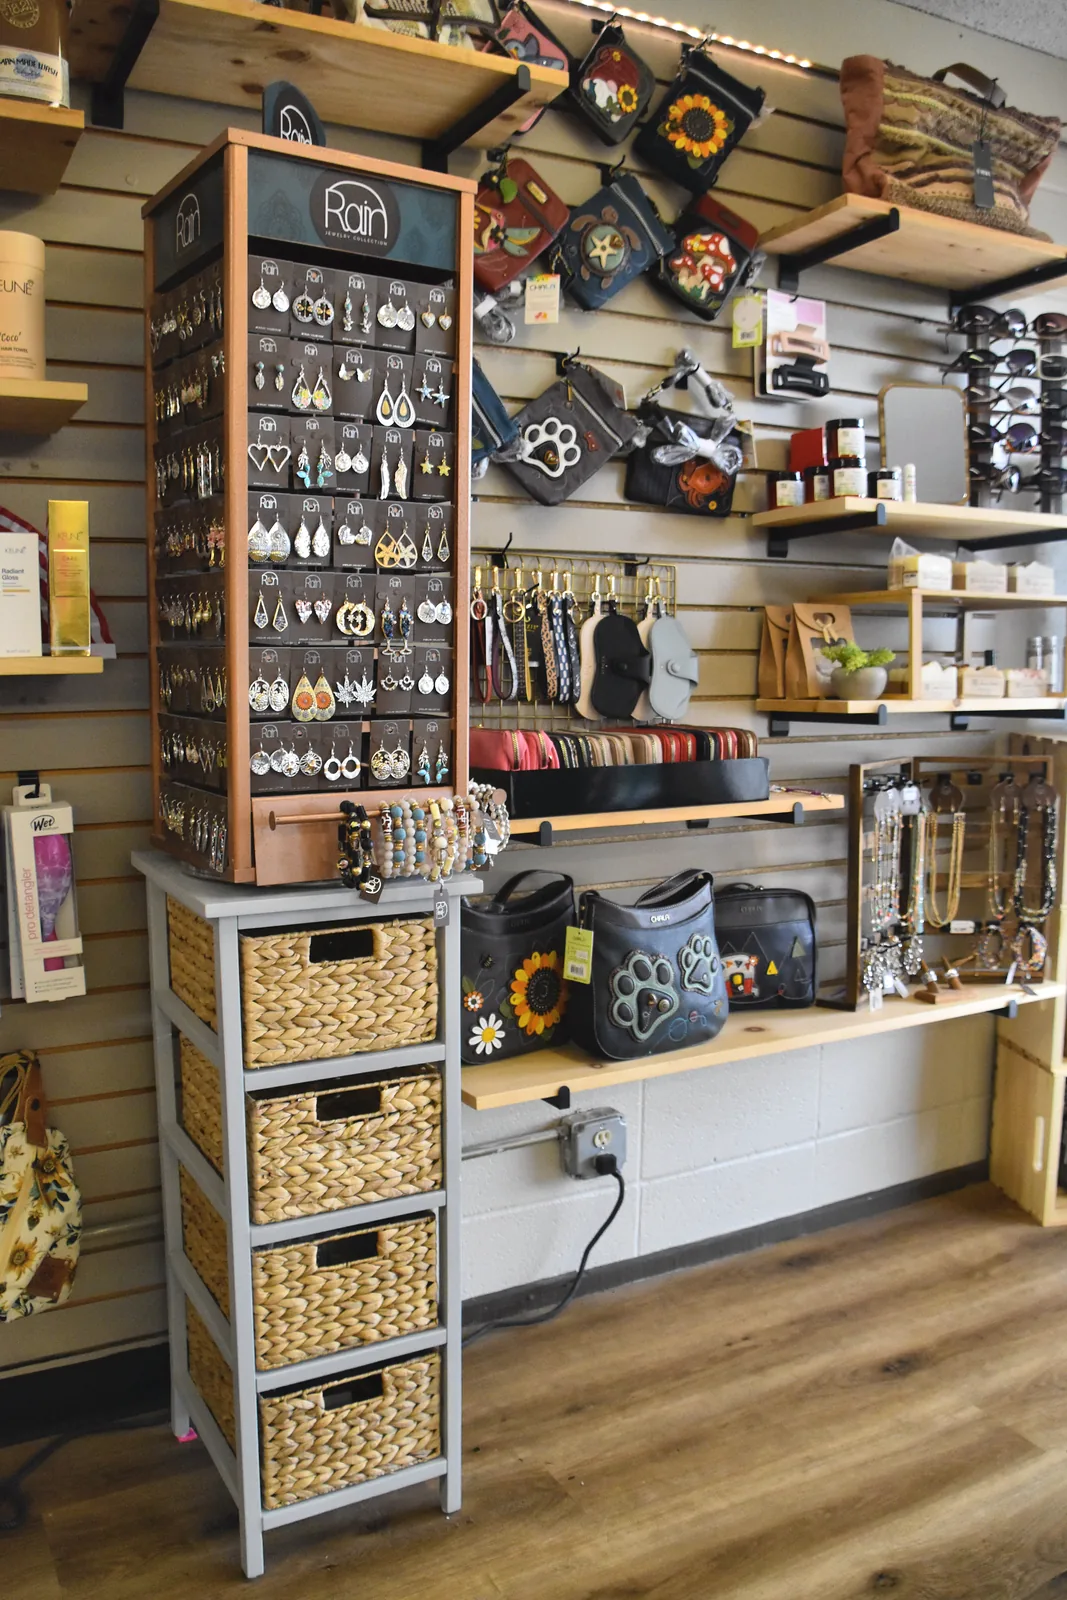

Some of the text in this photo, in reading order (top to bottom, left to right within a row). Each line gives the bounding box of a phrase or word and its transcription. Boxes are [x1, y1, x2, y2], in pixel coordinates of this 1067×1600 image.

[325, 181, 388, 239] Rain
[176, 193, 201, 253] Rain
[325, 230, 388, 247] JEWELRY COLLECTION
[262, 260, 279, 276] Rain
[259, 416, 277, 431] Rain
[260, 494, 277, 509] Rain
[33, 817, 53, 831] Wet
[21, 868, 39, 940] pro detangler
